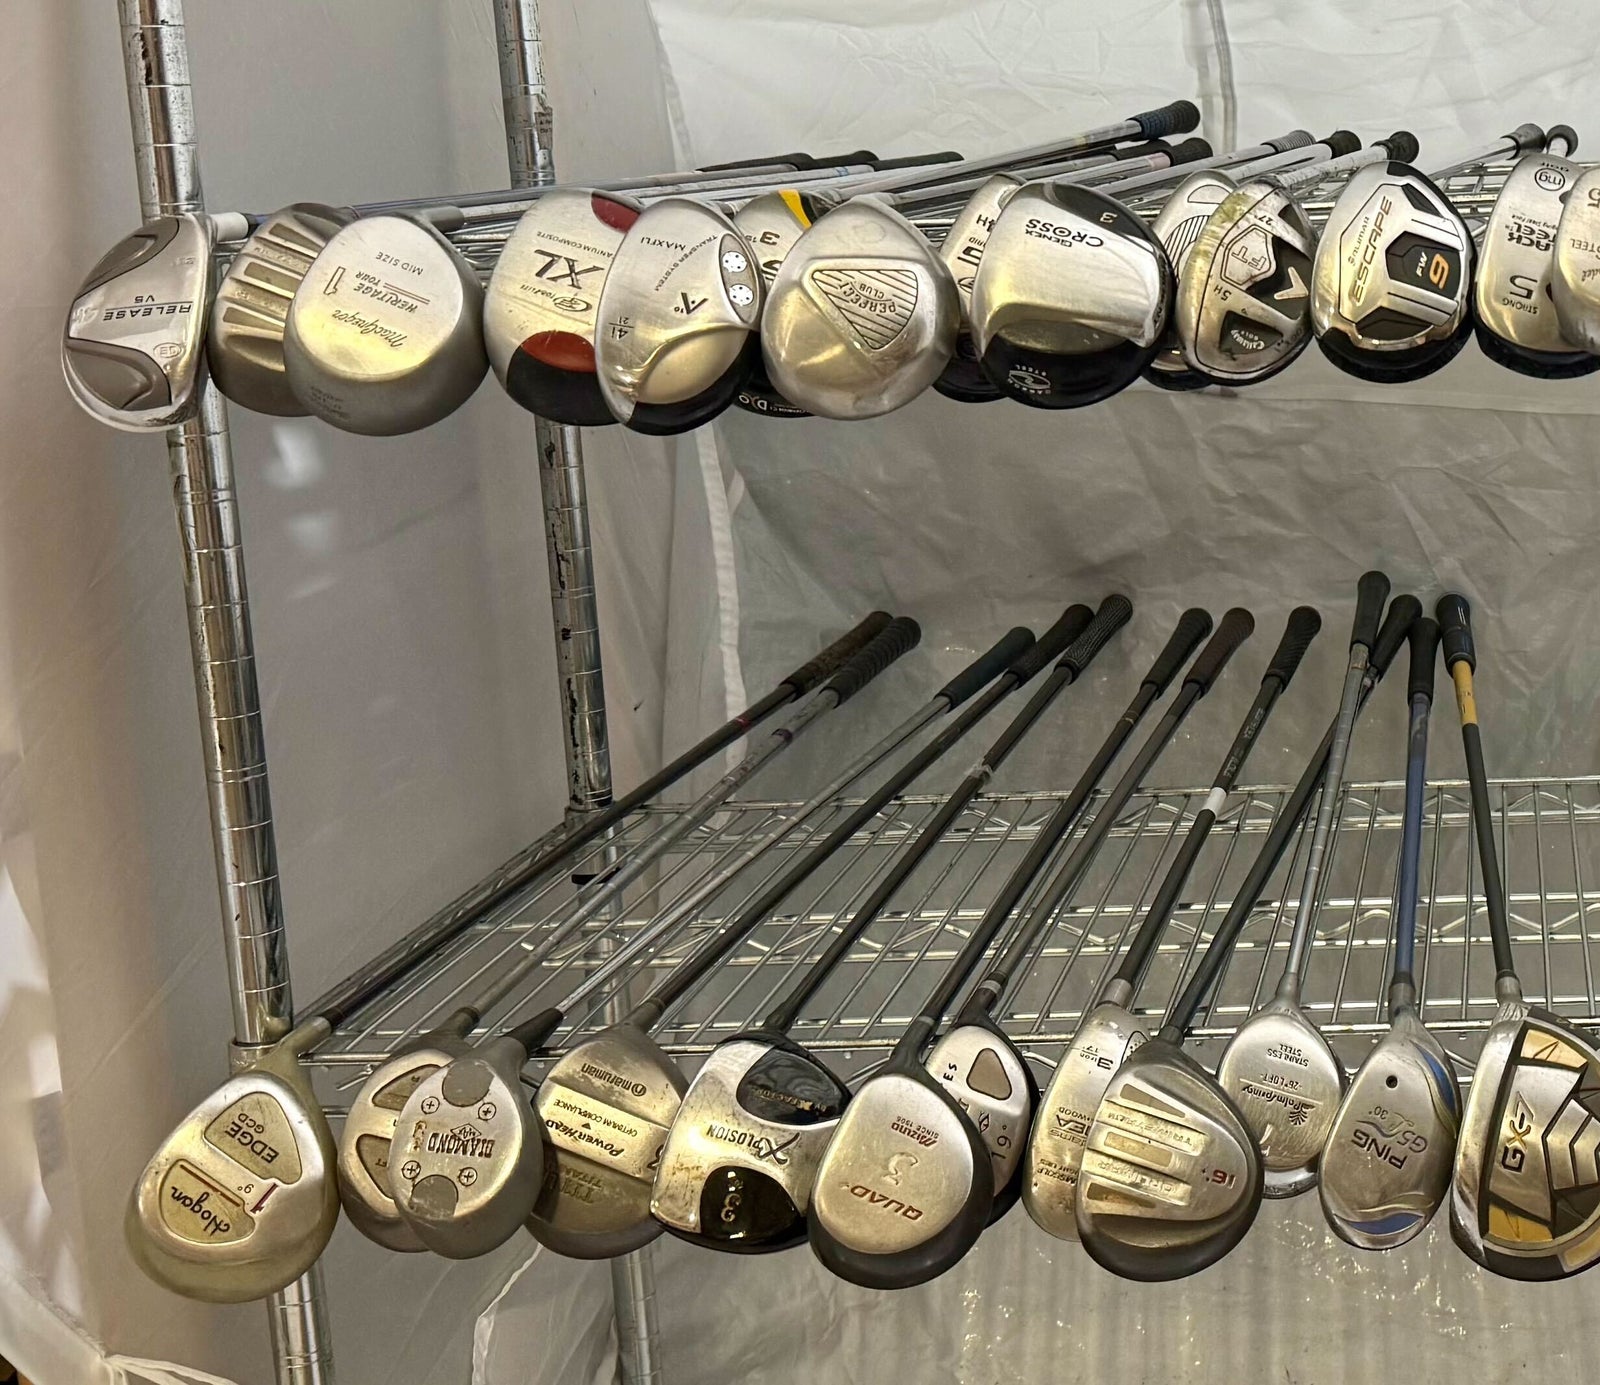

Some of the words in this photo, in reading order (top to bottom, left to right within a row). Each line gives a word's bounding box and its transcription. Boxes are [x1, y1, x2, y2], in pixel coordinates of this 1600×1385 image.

[1100, 210, 1118, 224] 3
[536, 231, 578, 251] COMPOSITE
[640, 236, 686, 253] MAXFLI
[759, 231, 780, 247] 3
[1024, 217, 1104, 249] CROSS
[1024, 228, 1073, 249] GENEX
[375, 250, 399, 266] SIZE
[578, 243, 614, 259] ANIUM
[1231, 244, 1267, 272] FT
[1350, 194, 1394, 304] ESCAPE
[399, 258, 424, 276] MID
[533, 248, 606, 290] XL
[653, 264, 679, 293] SYSTEM
[322, 266, 345, 298] 1
[859, 282, 885, 301] CLUB
[1508, 274, 1538, 301] 5
[134, 294, 156, 303] V5
[353, 282, 418, 313] HERITAGE
[839, 281, 897, 315] PERFECT
[1501, 297, 1539, 316] STRONG
[103, 304, 193, 321] RELEASE
[331, 308, 409, 350] MacGregor
[1229, 327, 1266, 350] Callaway
[1266, 1047, 1310, 1067] STAINLESS
[1279, 1043, 1302, 1054] STEEL
[580, 1063, 632, 1092] maruman
[554, 1097, 604, 1125] COMPLIANCE
[545, 1118, 584, 1143] HEAD
[603, 1114, 639, 1138] OPTIMUM
[890, 1122, 939, 1148] MIZUNO
[1500, 1089, 1537, 1174] GX-7
[225, 1119, 279, 1165] EDGE
[426, 1131, 495, 1159] DIAMOND
[584, 1130, 626, 1158] POWER
[1352, 1128, 1408, 1170] PING
[1399, 1130, 1428, 1154] G5
[169, 1184, 231, 1237] Hogan
[849, 1184, 924, 1222] QUAD
